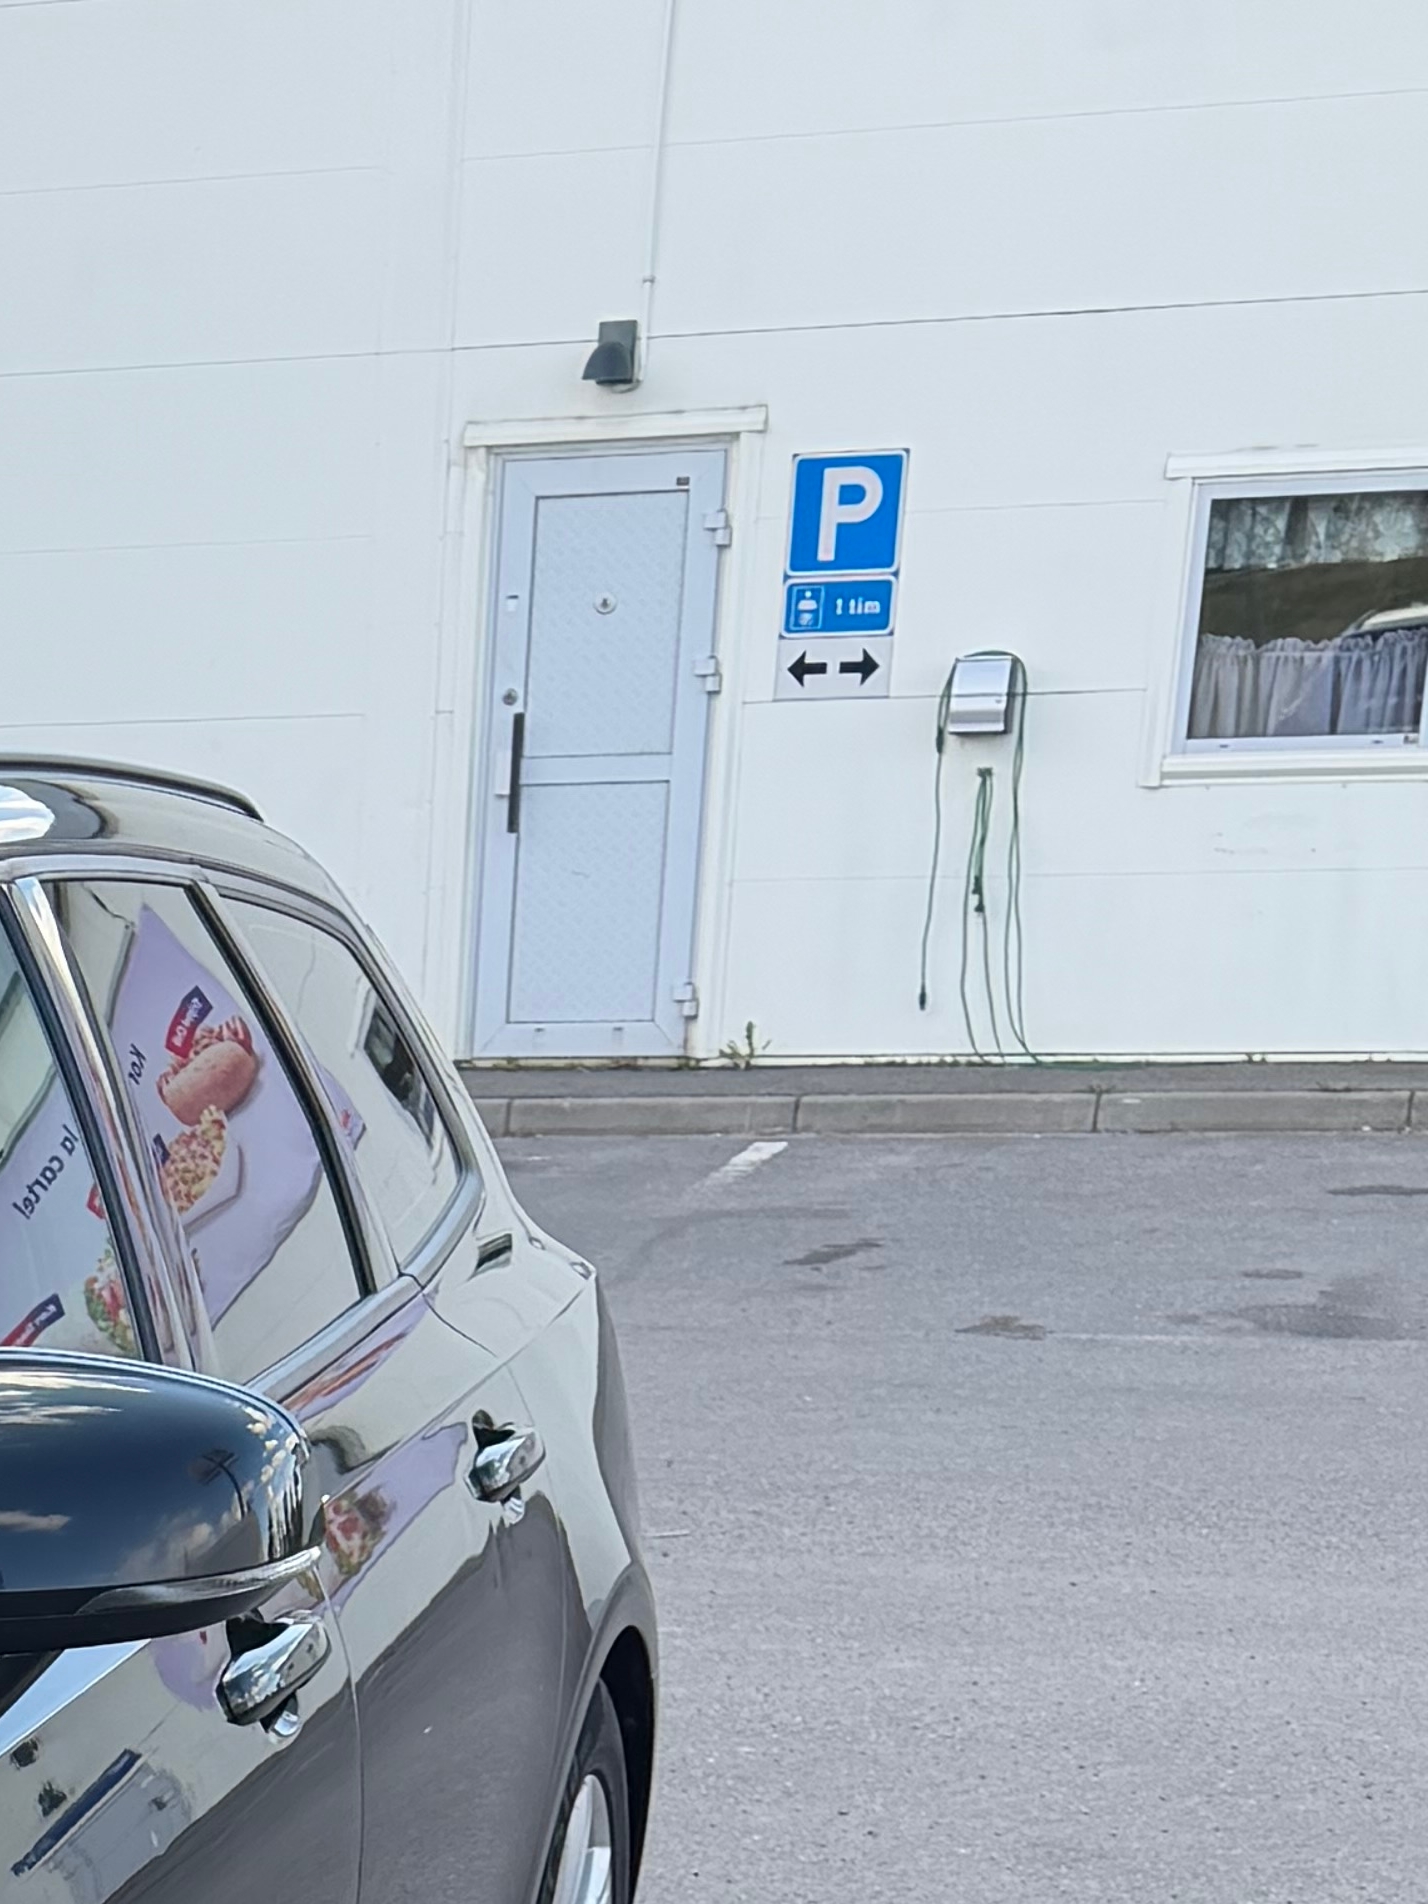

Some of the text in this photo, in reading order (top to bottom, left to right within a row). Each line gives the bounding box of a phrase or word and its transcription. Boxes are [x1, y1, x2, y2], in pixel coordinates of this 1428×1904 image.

[816, 465, 883, 562] P
[835, 597, 881, 616] 1 tim
